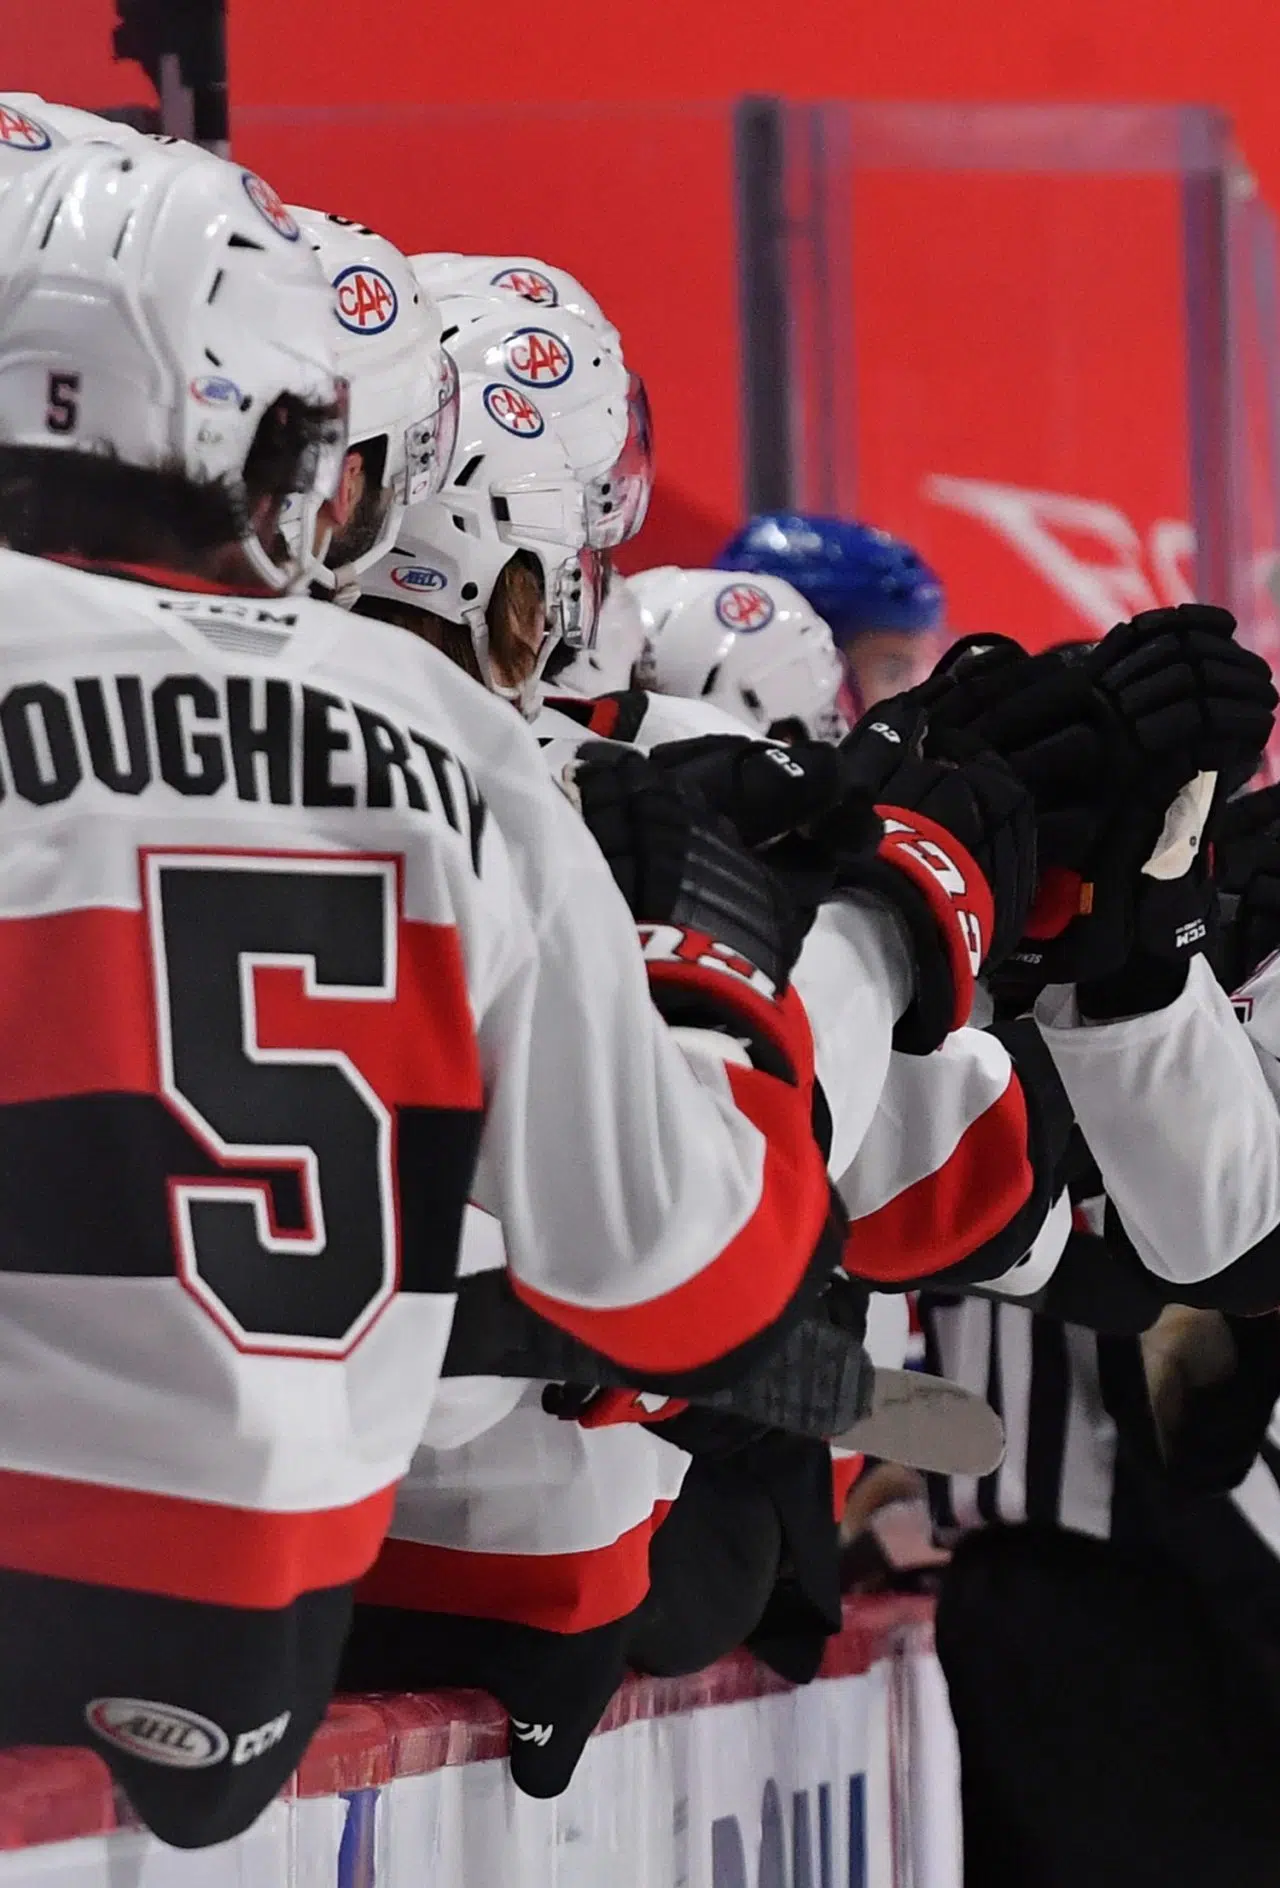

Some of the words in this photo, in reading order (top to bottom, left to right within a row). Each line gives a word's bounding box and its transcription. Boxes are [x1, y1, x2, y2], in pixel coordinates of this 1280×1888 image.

[338, 273, 393, 326] CAA
[510, 334, 568, 380] CAA
[47, 371, 80, 432] 5
[490, 388, 541, 429] CAA
[0, 673, 488, 881] OUGHERTY
[1175, 923, 1207, 948] CCM
[138, 846, 405, 1361] 5
